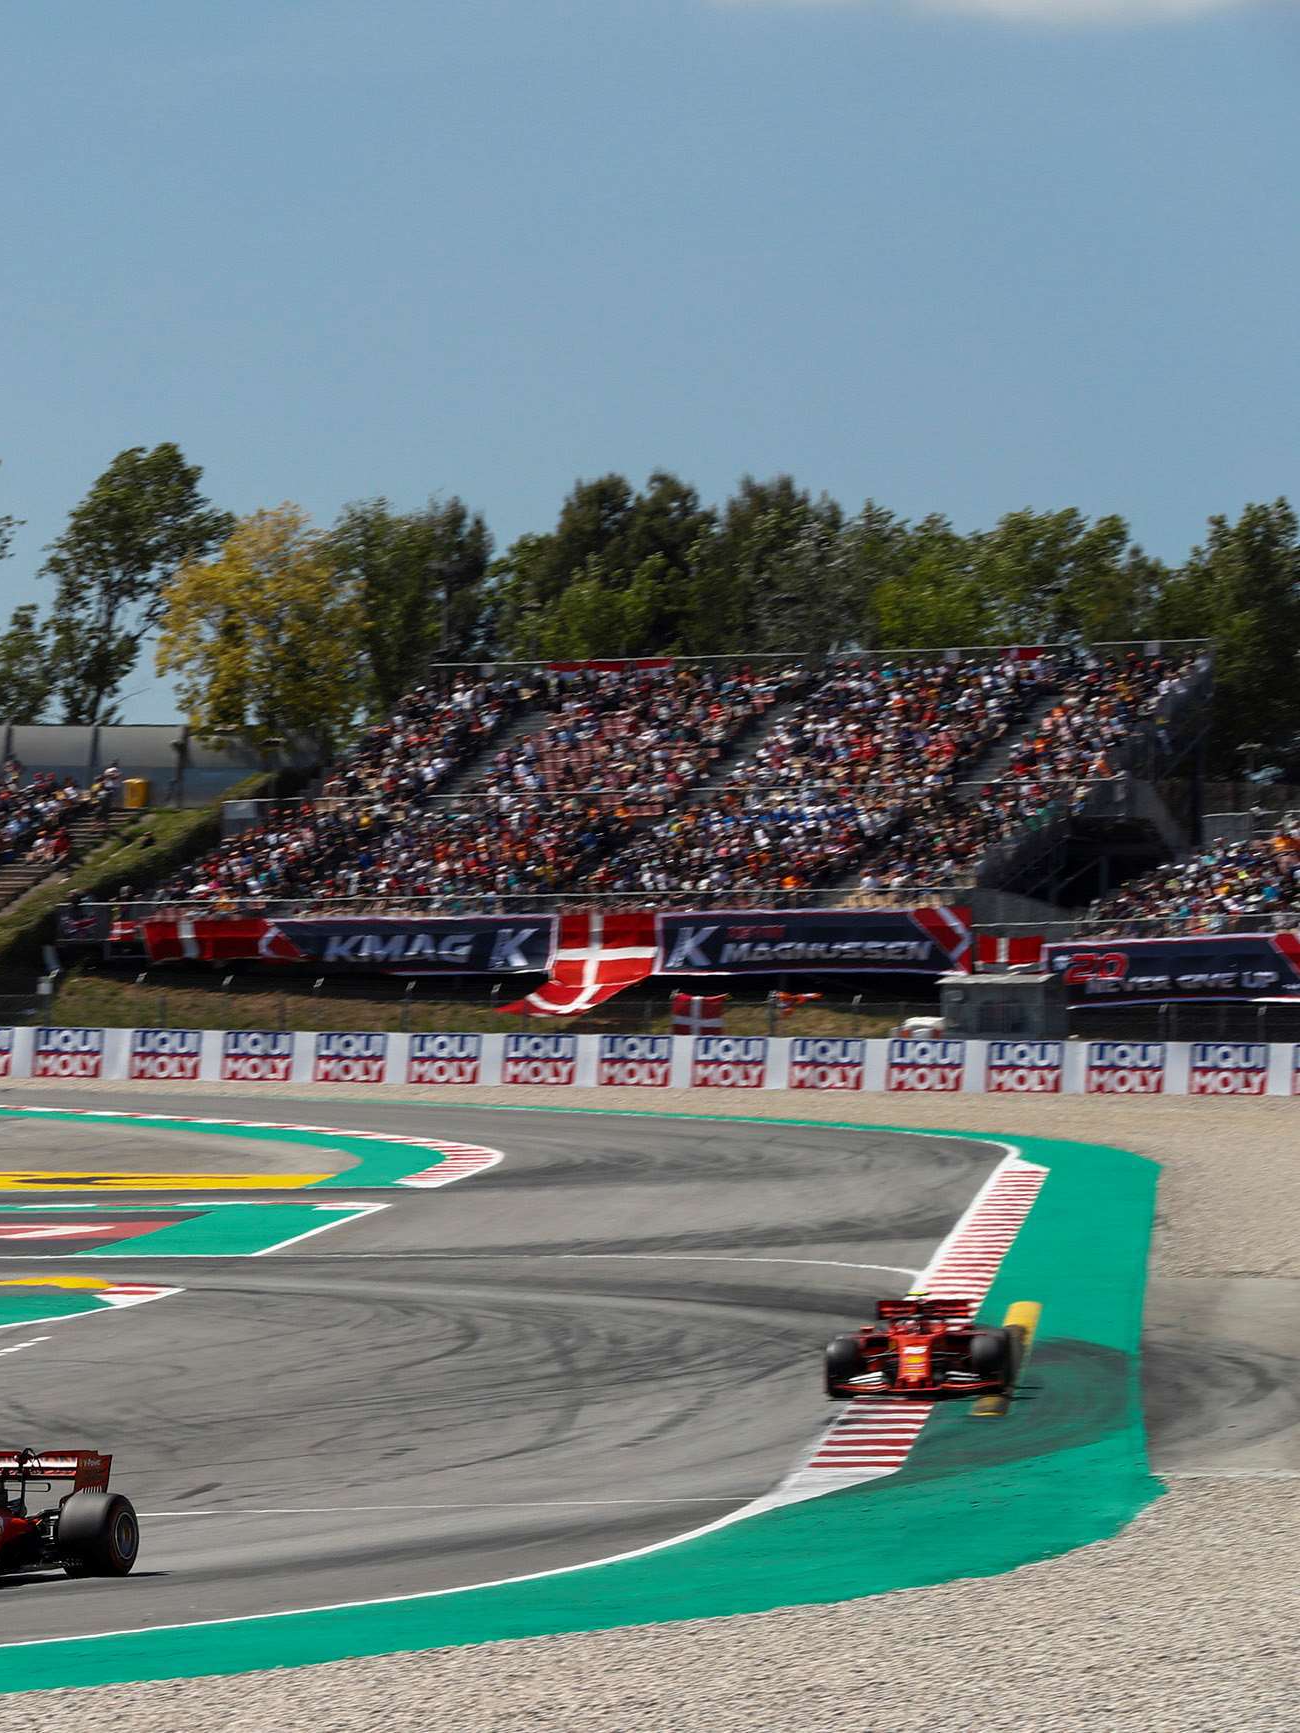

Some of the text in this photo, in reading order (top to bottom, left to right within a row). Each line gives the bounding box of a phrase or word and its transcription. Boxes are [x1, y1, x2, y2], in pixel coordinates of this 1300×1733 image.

[323, 934, 476, 962] KMAG
[1064, 953, 1129, 985] 20
[37, 1030, 103, 1051] LIQUI
[134, 1031, 200, 1053] LIQUI
[225, 1033, 293, 1055] LIQUI
[317, 1034, 387, 1056] LIQUI
[411, 1035, 480, 1057] LIQUI
[506, 1036, 575, 1058] LIQUI
[602, 1037, 671, 1059] LIQUI
[696, 1039, 766, 1060] LIQUI
[794, 1040, 863, 1062] LIQUI
[892, 1041, 964, 1063] LIQUI
[990, 1043, 1062, 1066] LIQUI
[1090, 1044, 1164, 1067] LIQUI
[1192, 1045, 1268, 1068] LIQUI
[35, 1055, 102, 1076] MOLY
[132, 1056, 199, 1078] MOLY
[224, 1058, 291, 1080] MOLY
[316, 1059, 385, 1081] MOLY
[409, 1060, 479, 1083] MOLY
[504, 1061, 575, 1083] MOLY
[600, 1062, 670, 1085] MOLY
[694, 1063, 765, 1086] MOLY
[791, 1065, 863, 1088] MOLY
[890, 1067, 963, 1090] MOLY
[987, 1069, 1060, 1092] MOLY
[1088, 1070, 1164, 1092] MOLY
[1190, 1071, 1268, 1094] MOLY
